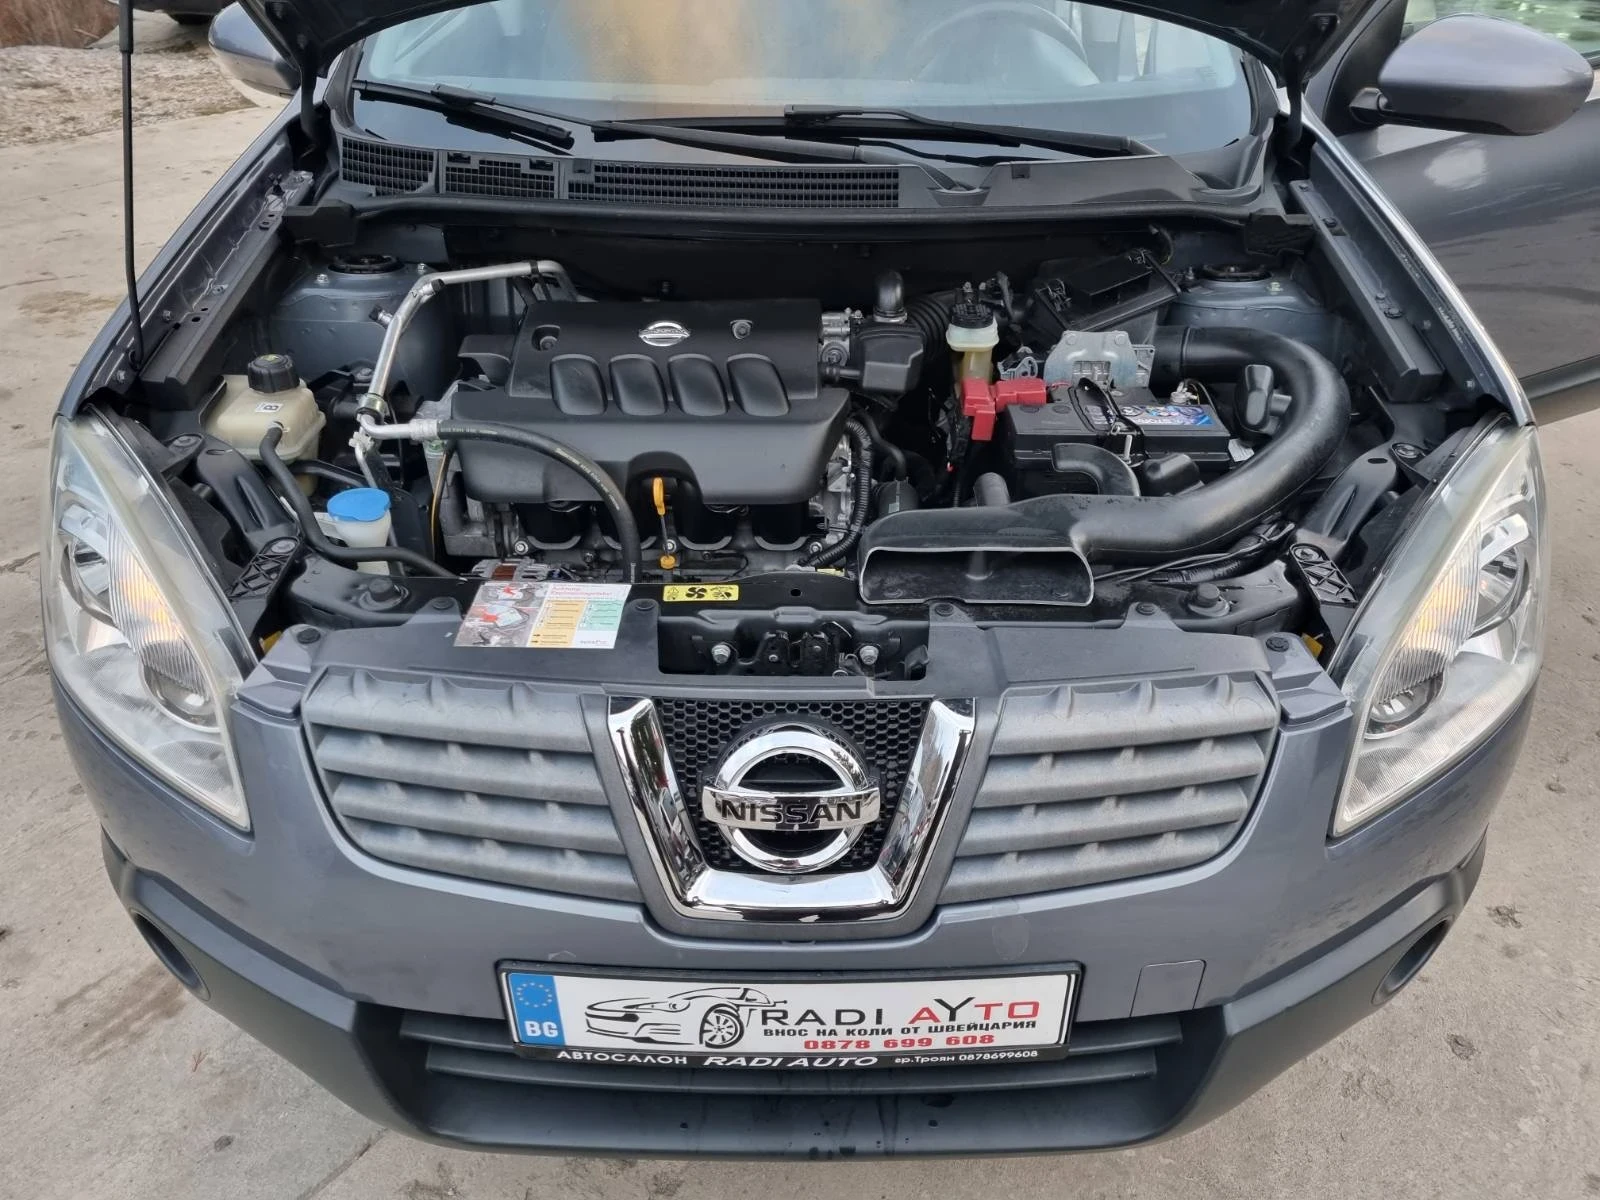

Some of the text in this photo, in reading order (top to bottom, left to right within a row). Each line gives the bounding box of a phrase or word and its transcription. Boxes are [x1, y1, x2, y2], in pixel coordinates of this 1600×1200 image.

[721, 800, 861, 824] NISSAN
[761, 1008, 883, 1026] RADI
[524, 1020, 559, 1038] BG
[763, 1020, 1037, 1037] ВНОС НА КОЛИ ОТ ШВЕЙЦАРИЯ
[804, 1034, 995, 1050] 0878 699 608
[556, 1050, 688, 1065] АВТОСАЛОН
[703, 1056, 784, 1067] RADI
[786, 1056, 879, 1067] AUTO
[959, 1050, 1039, 1062] 0878699608
